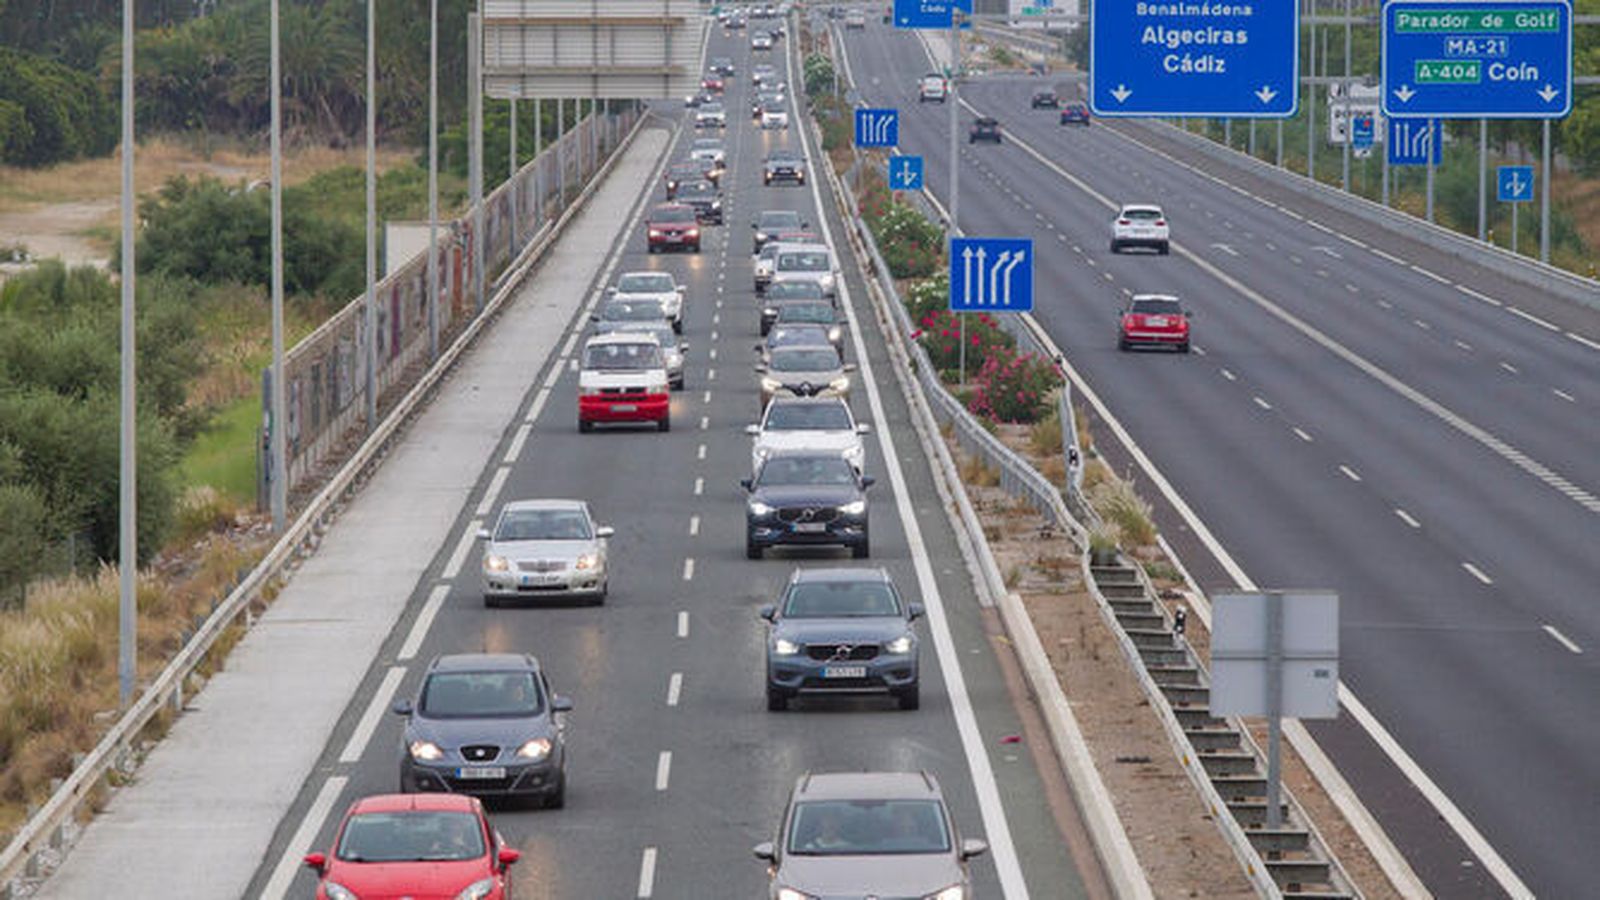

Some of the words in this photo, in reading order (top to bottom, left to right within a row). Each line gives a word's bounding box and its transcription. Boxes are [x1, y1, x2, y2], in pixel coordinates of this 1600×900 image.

[1136, 1, 1252, 16] Benalmádena
[1398, 13, 1470, 29] Parador
[1480, 13, 1504, 28] de
[1515, 12, 1556, 28] Golf
[1141, 25, 1249, 49] Algeciras
[1447, 39, 1506, 55] MA-21
[1162, 53, 1226, 73] Cádiz
[1419, 64, 1477, 79] A-404
[1488, 62, 1539, 81] Coín
